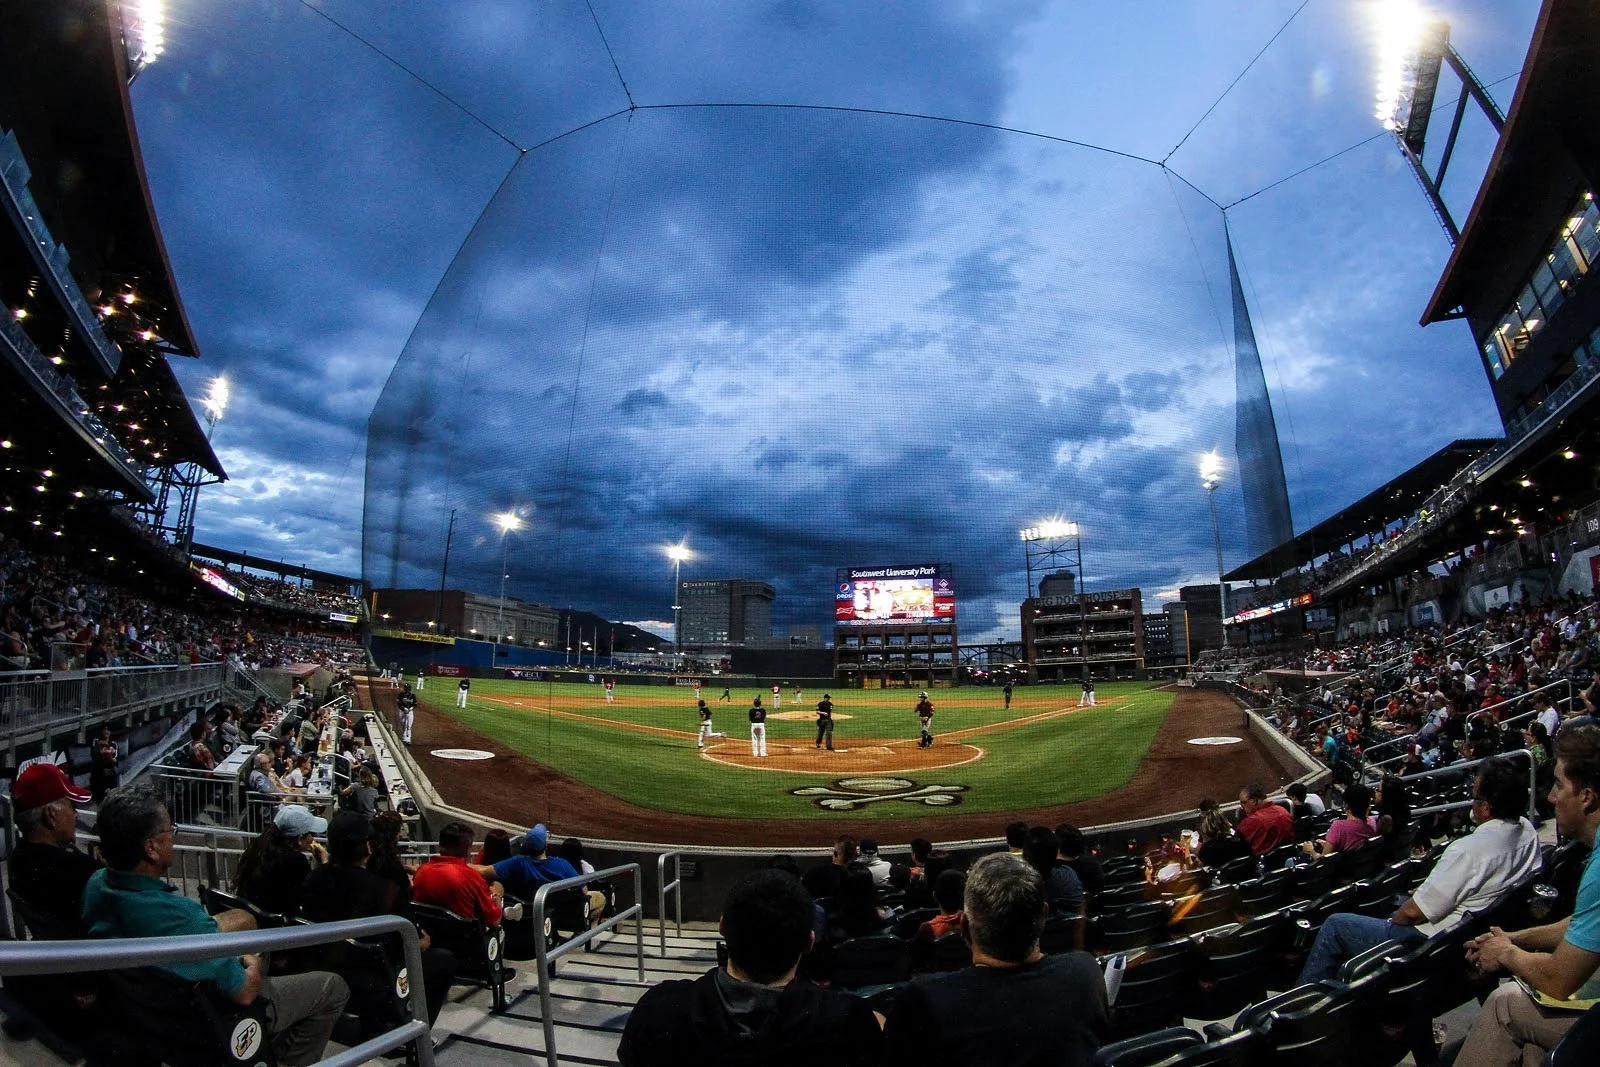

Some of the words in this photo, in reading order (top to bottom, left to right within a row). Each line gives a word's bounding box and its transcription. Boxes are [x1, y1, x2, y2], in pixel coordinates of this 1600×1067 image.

[1586, 518, 1599, 532] 109
[851, 570, 886, 578] Southwest
[886, 568, 919, 577] University
[919, 566, 936, 575] Park
[1056, 595, 1080, 605] DOG
[1086, 591, 1118, 602] HOUSE
